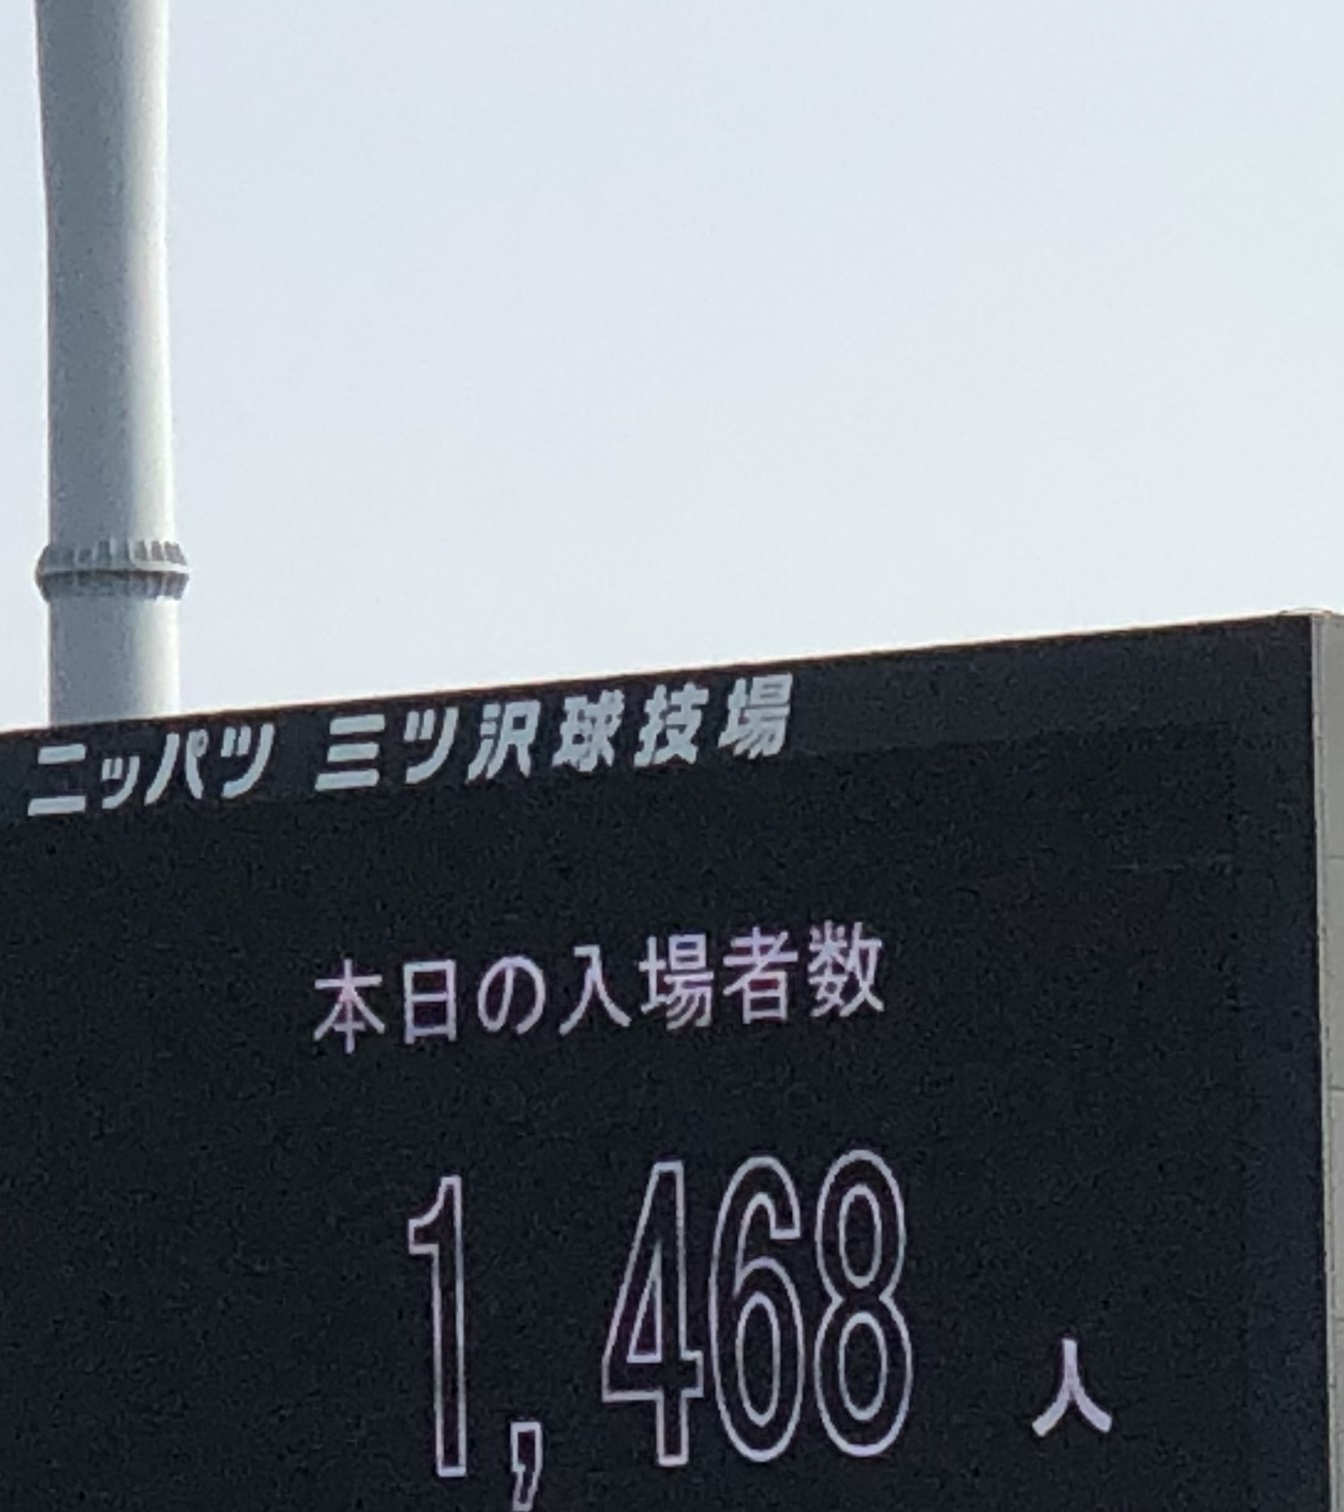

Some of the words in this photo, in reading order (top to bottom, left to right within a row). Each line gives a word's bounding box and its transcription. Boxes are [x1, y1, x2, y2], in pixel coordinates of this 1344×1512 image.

[28, 723, 276, 816] ニッパツ
[315, 673, 793, 791] 三ツ沢球技場
[314, 921, 885, 1054] 本日の入場者数
[408, 1149, 914, 1512] 1,468
[1032, 1338, 1113, 1436] 人
